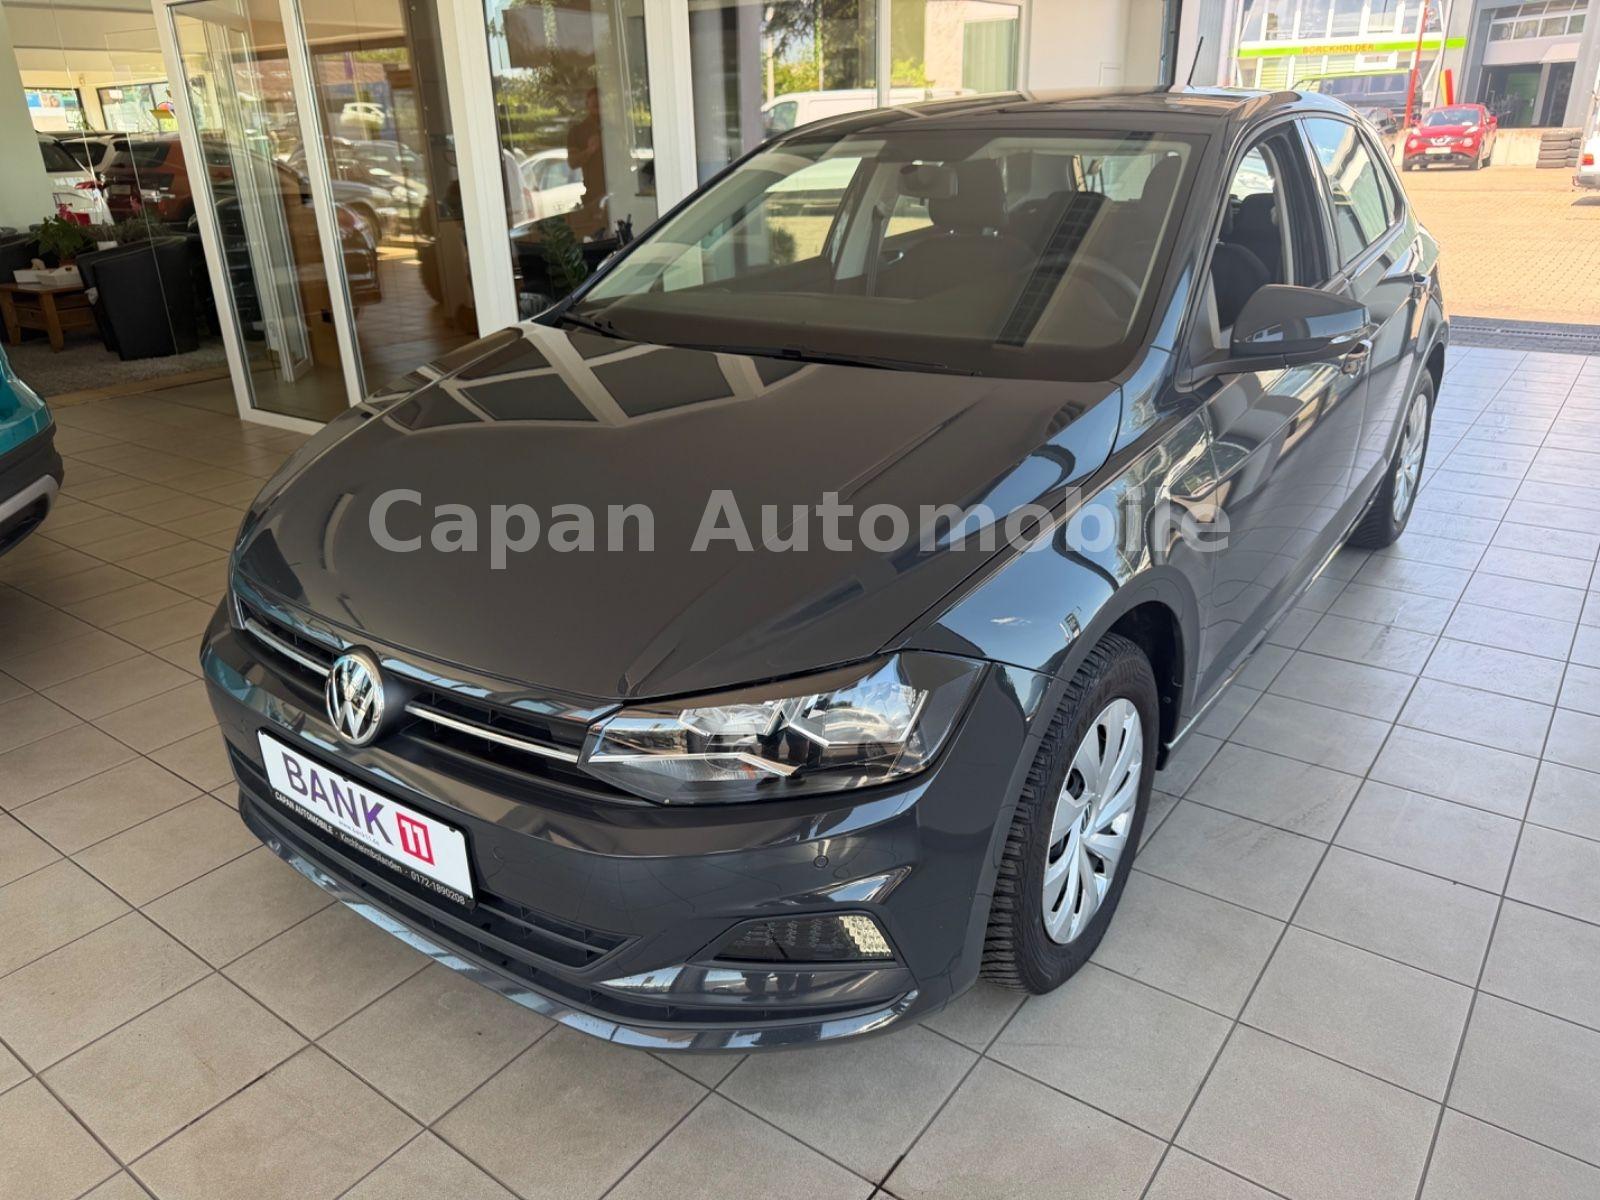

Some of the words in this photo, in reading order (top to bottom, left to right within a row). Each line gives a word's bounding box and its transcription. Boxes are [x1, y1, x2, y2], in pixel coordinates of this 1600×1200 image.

[274, 791, 295, 810] CAPAN
[295, 804, 334, 835] AUTOMOBILE
[281, 752, 394, 846] BANK
